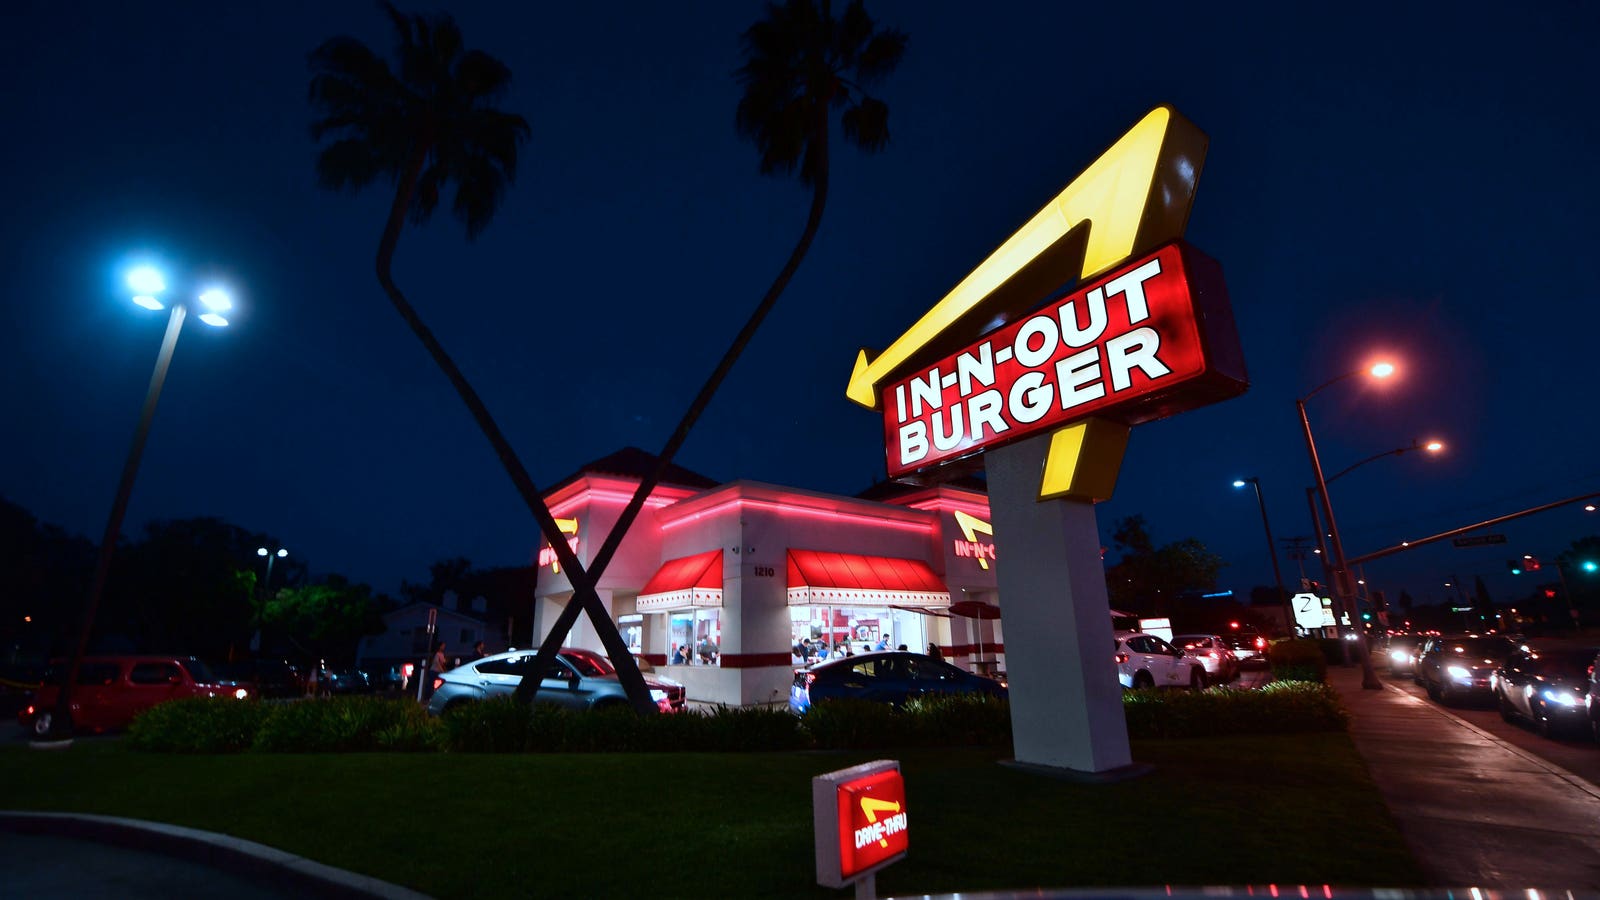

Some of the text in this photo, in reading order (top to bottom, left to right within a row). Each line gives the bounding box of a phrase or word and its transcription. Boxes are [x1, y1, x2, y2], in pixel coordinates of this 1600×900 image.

[896, 258, 1162, 423] IN-N-OUT
[899, 327, 1174, 466] BURGER
[754, 565, 775, 577] 1210
[855, 812, 908, 849] DRIVE-THRU
